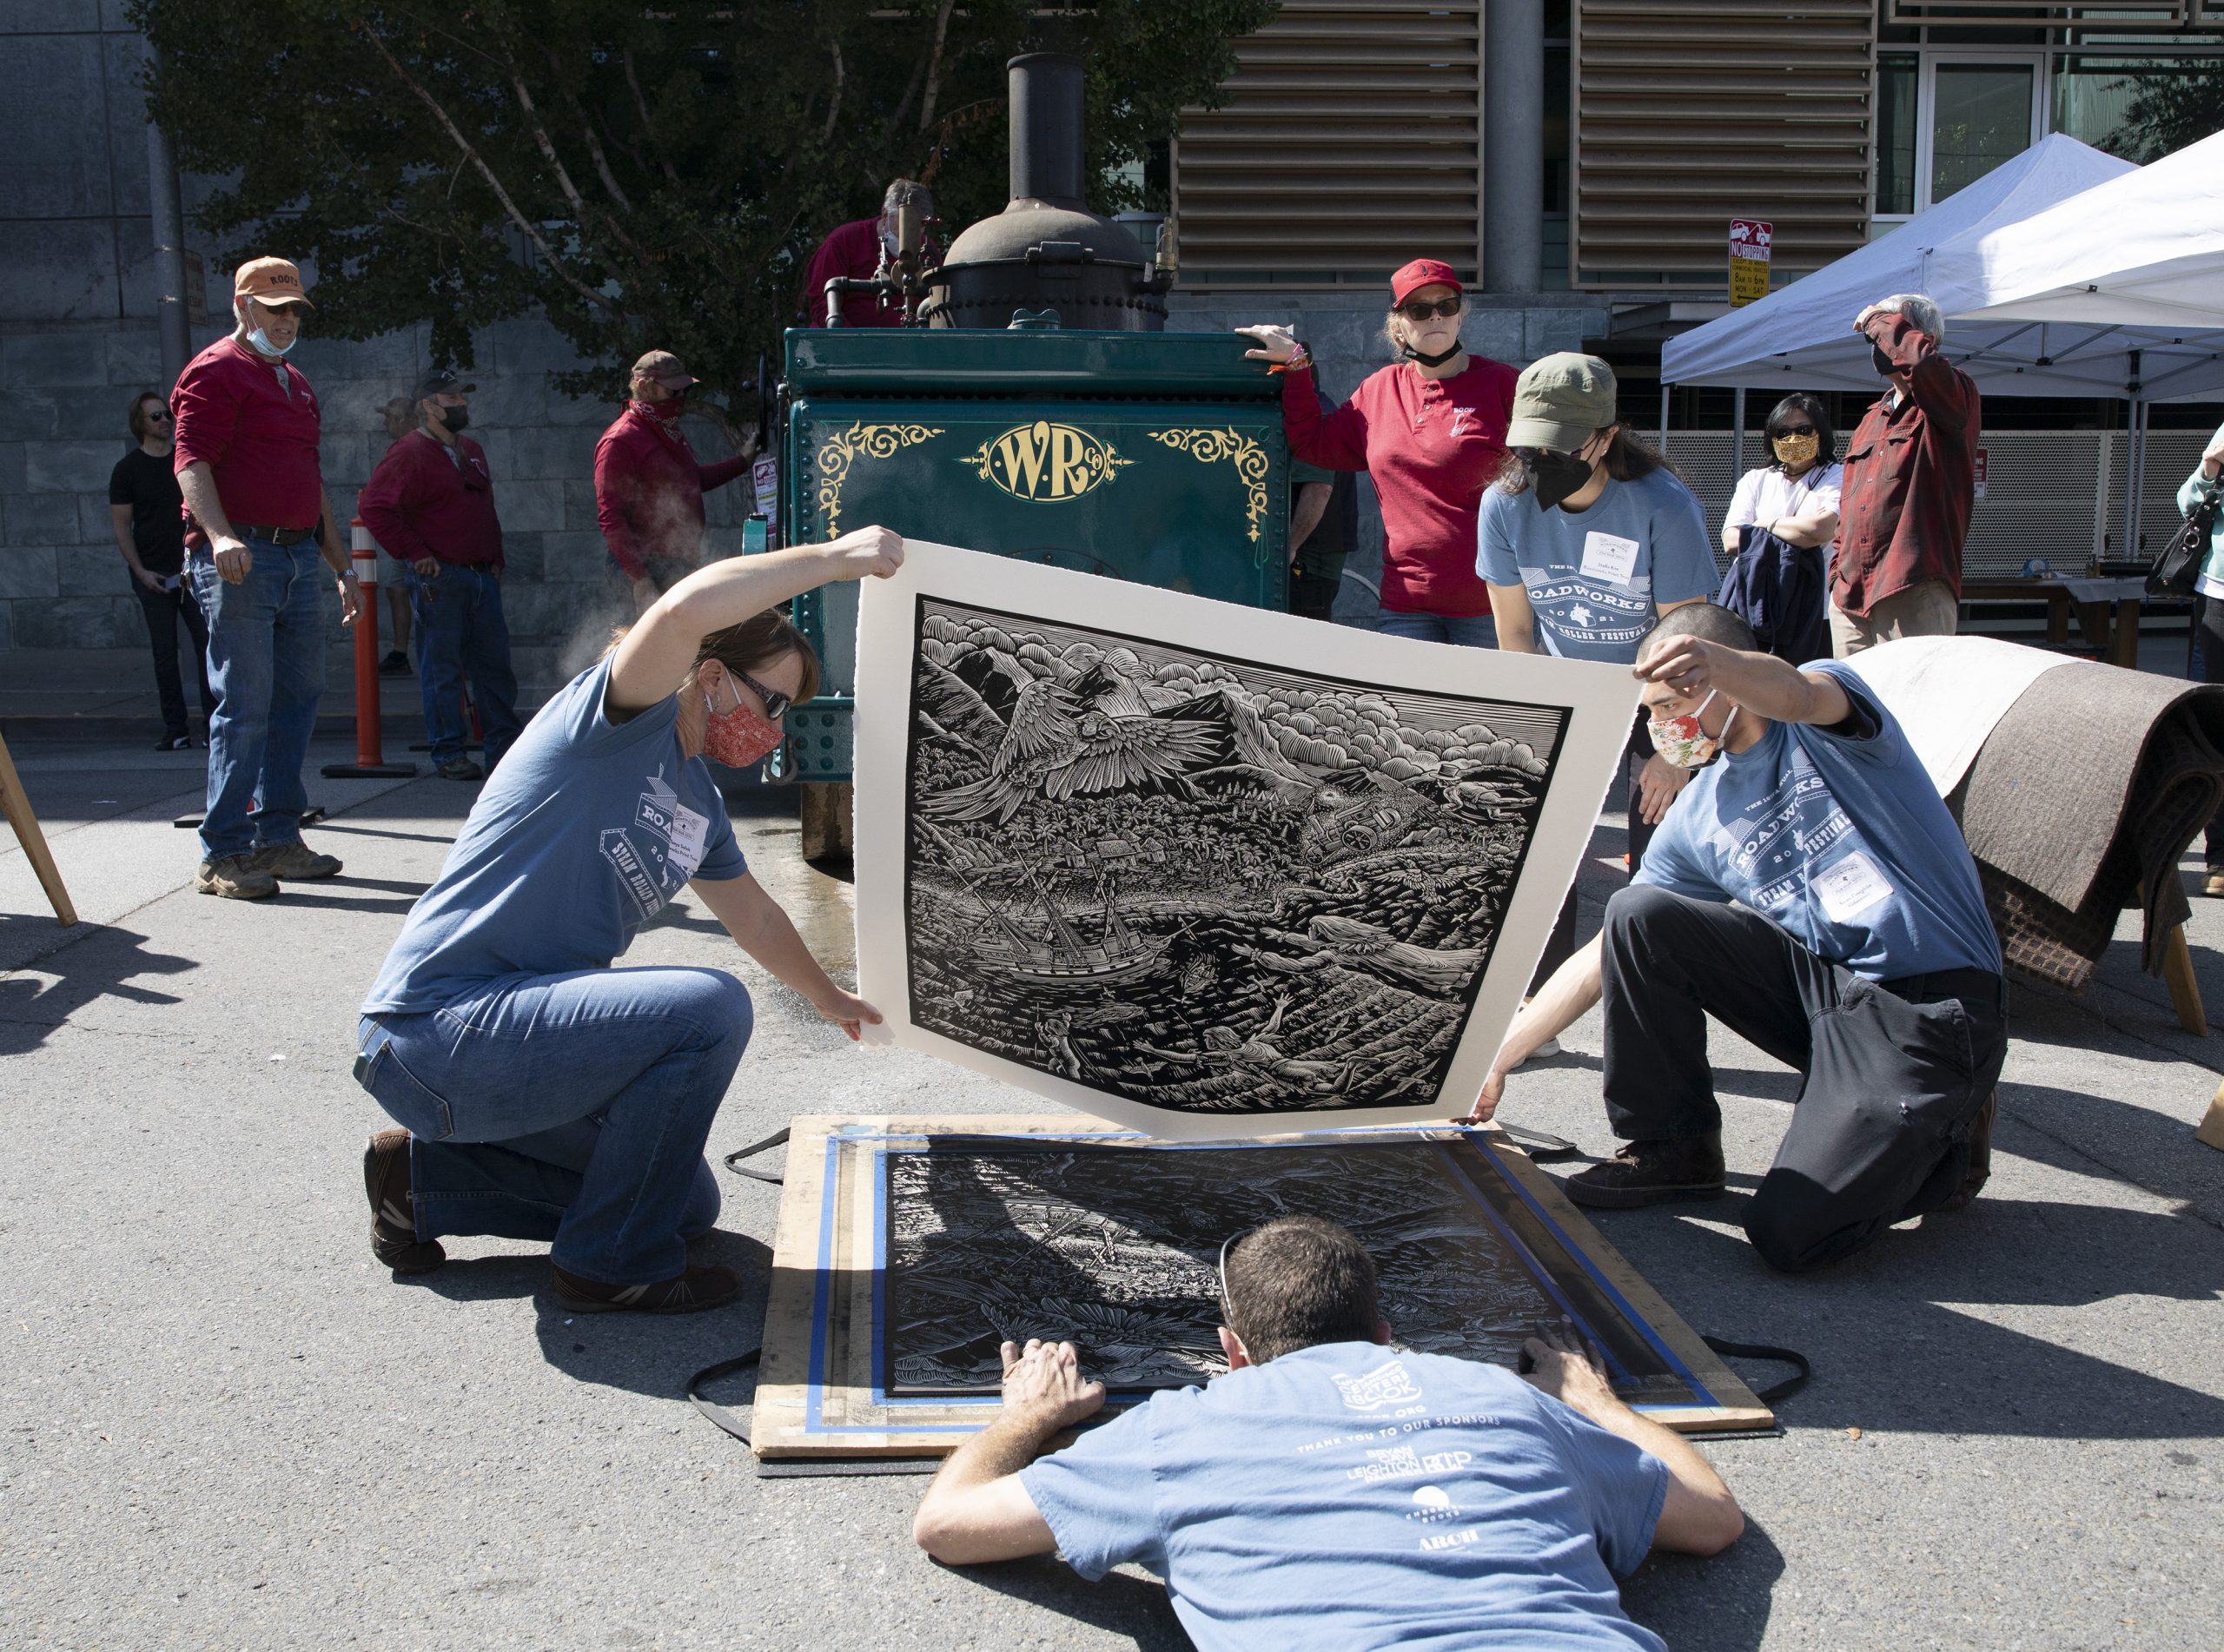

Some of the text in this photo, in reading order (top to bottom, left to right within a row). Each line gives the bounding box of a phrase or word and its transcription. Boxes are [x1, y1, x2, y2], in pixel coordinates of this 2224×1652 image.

[1731, 241, 1769, 261] NO STOPPING
[269, 274, 298, 287] ROOTS
[1753, 287, 1764, 295] SAT
[1530, 585, 1647, 611] OADWORKS
[1600, 626, 1646, 641] FESTIVAL
[1744, 800, 1763, 812] THE
[1804, 813, 1850, 856] FESTIVAL
[611, 842, 639, 874] STEAM
[630, 873, 654, 901] ROLLER
[1757, 880, 1795, 907] STEAM
[1296, 1415, 1501, 1454] THANK YOU TO OUR SPONSORS
[1346, 1458, 1421, 1480] LEIGHTON
